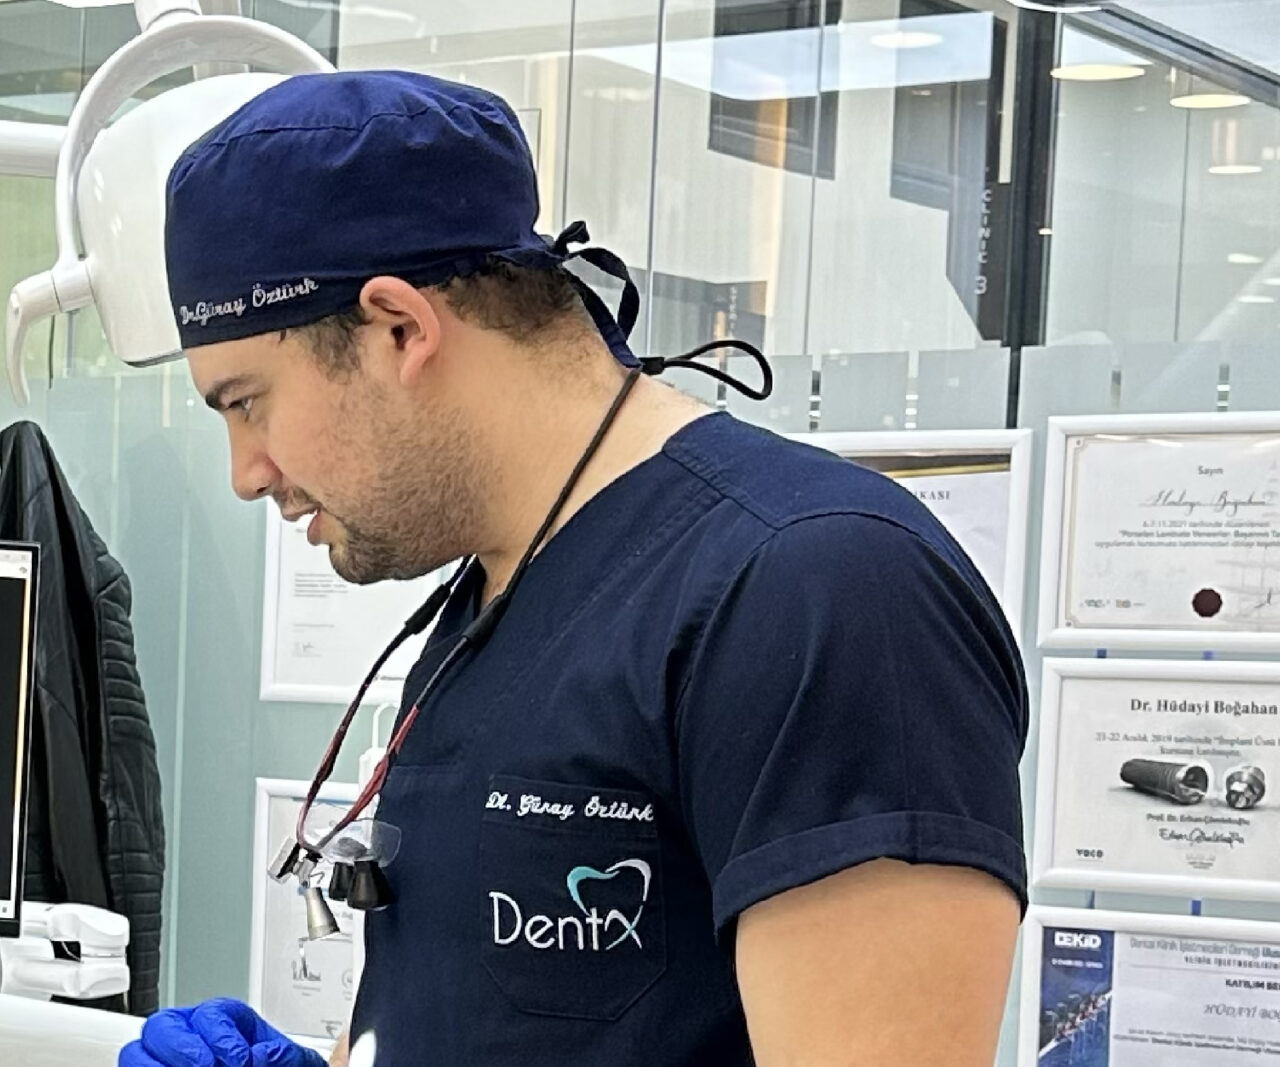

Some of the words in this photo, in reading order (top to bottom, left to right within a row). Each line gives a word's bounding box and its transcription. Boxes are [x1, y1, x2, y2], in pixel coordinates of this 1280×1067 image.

[252, 277, 319, 308] Öztürk
[974, 275, 987, 294] 3
[914, 489, 950, 500] KASI
[1131, 698, 1152, 711] Dr.
[1214, 700, 1278, 716] Boğahan
[517, 794, 575, 821] Güray
[584, 795, 654, 822] Öztürk
